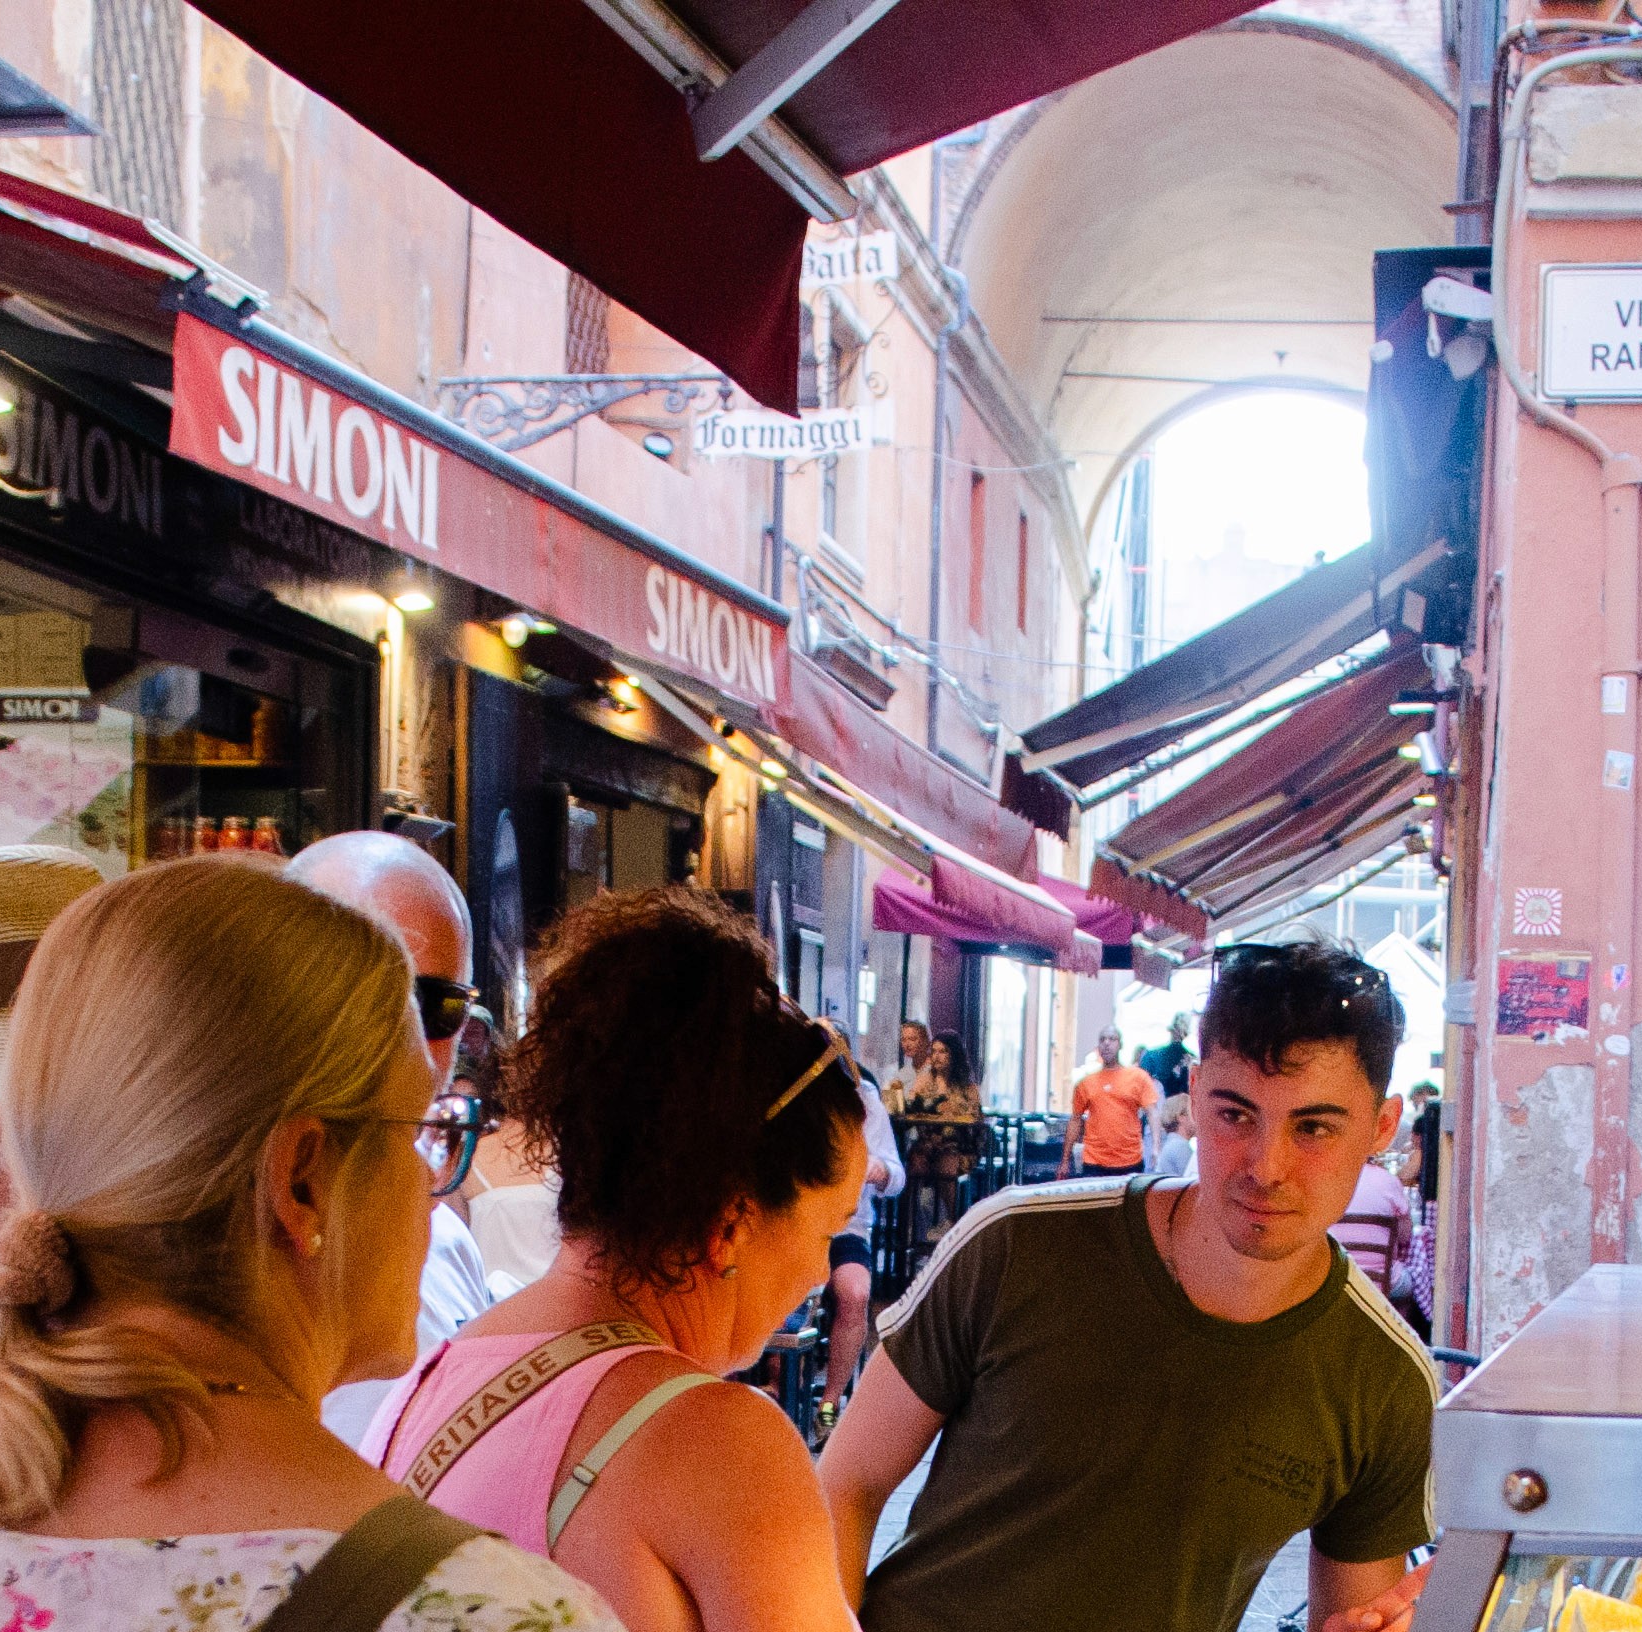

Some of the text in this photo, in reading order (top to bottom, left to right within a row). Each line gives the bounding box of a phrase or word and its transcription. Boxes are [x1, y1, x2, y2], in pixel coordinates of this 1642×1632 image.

[218, 346, 440, 552] SIMONI
[694, 413, 863, 452] Formaggi
[644, 564, 777, 702] SIMONI
[404, 1350, 560, 1497] ERITAGE
